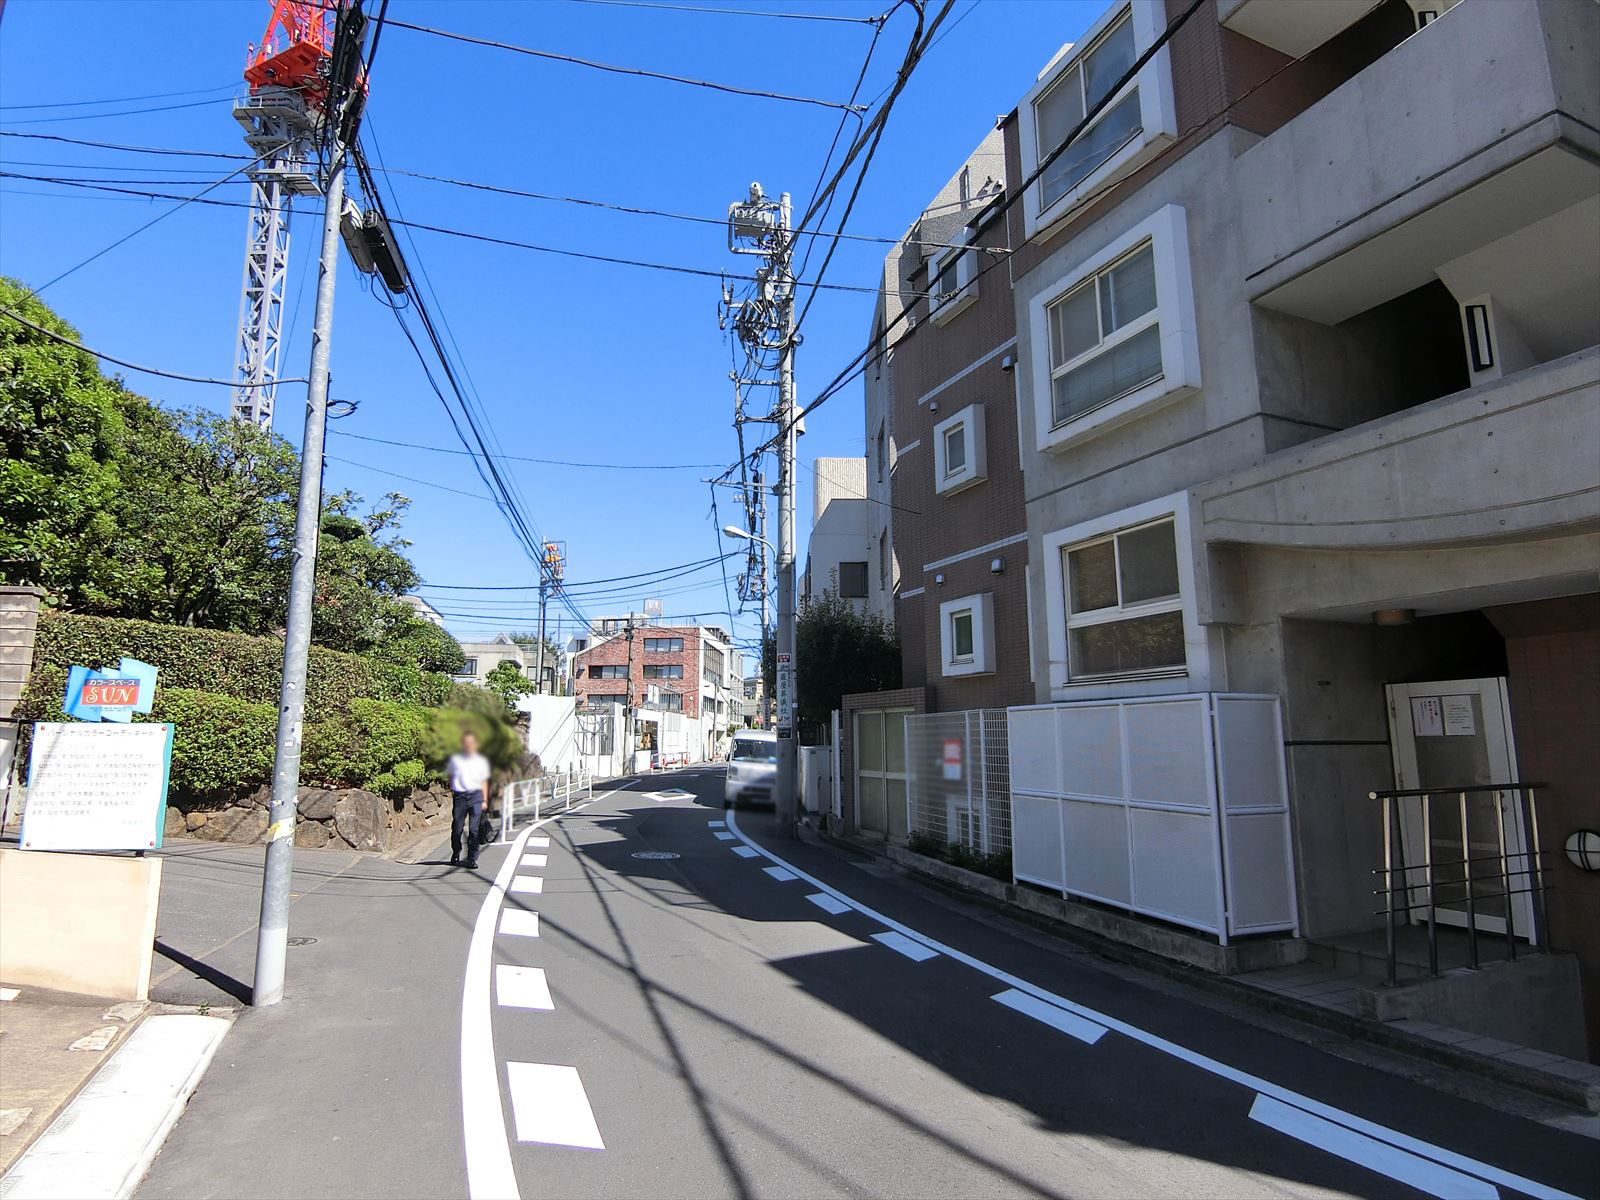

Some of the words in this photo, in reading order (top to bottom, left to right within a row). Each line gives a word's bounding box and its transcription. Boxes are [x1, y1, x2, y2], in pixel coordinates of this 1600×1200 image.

[86, 686, 135, 703] SUN
[47, 728, 155, 737] パーソナルカラーコーディネート
